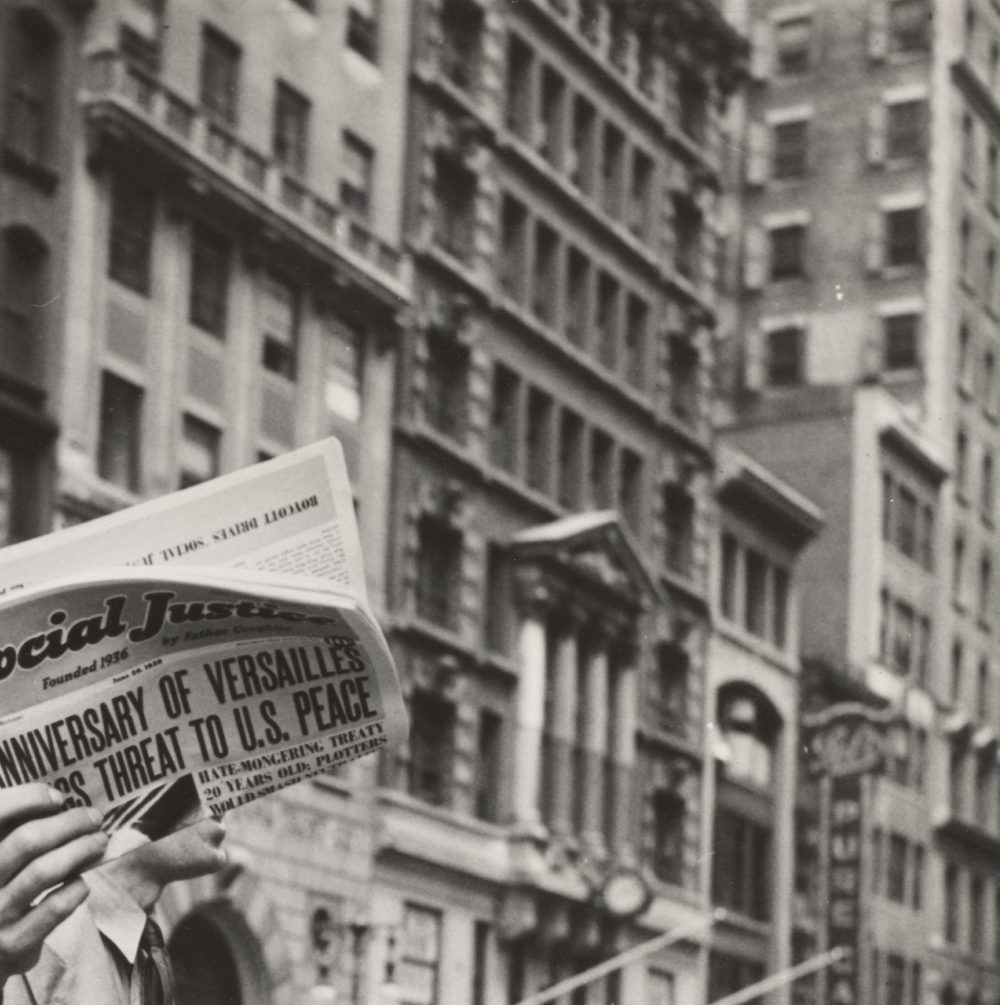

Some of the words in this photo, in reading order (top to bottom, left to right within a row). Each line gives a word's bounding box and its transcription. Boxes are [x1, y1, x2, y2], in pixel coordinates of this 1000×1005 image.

[212, 516, 259, 543] DRIVES
[263, 494, 319, 526] BOYCOTT
[128, 591, 336, 643] Justice
[42, 659, 98, 691] Founded
[99, 646, 130, 671] 1936
[161, 635, 180, 648] by
[182, 626, 229, 643] Father
[158, 669, 192, 720] OF
[203, 646, 366, 705] VERSAILLES
[93, 726, 186, 802] THREAT
[189, 714, 229, 762] TO
[232, 699, 290, 752] U.S.
[292, 675, 378, 736] PEACE
[328, 721, 386, 748] TREATY
[203, 785, 222, 802] 20
[225, 772, 273, 794] YEARS
[316, 734, 389, 767] PLOTTERS
